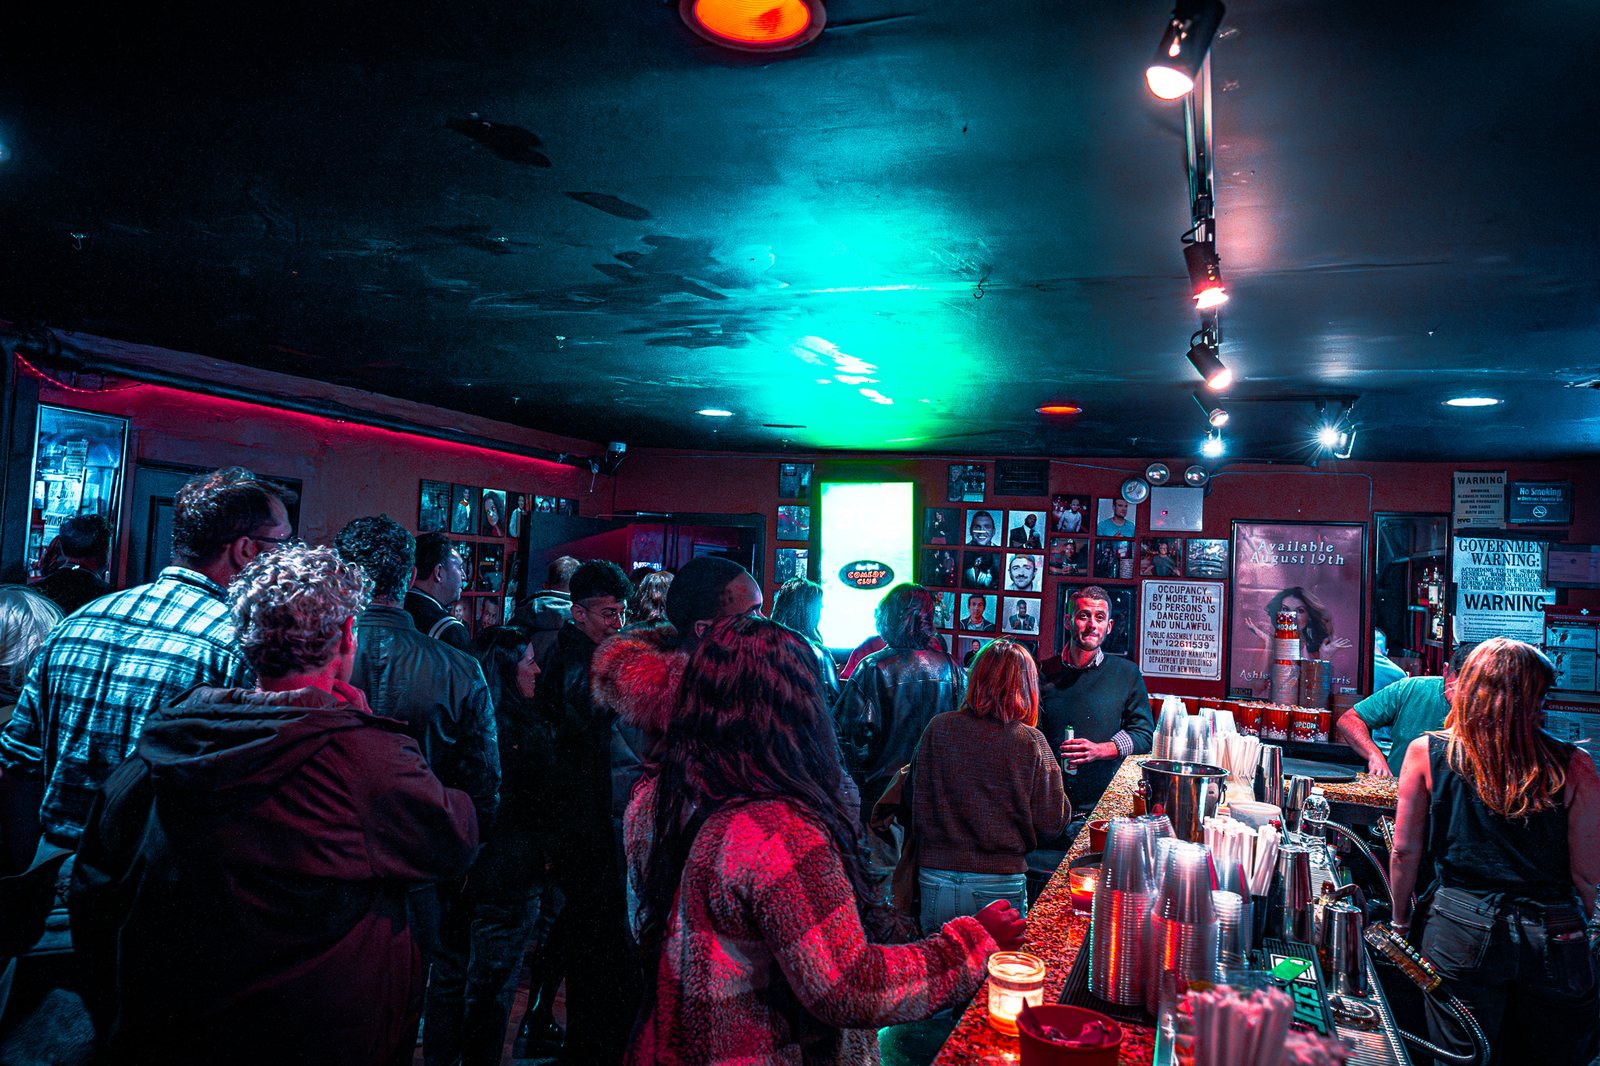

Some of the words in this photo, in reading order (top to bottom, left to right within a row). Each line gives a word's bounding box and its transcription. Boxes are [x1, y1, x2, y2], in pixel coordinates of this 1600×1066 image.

[1457, 476, 1503, 485] WARNING
[1520, 487, 1530, 495] No
[1531, 487, 1562, 496] Smoking
[1257, 540, 1334, 555] Available
[1459, 538, 1545, 554] GOVERNMEN
[1250, 551, 1305, 566] August
[1310, 553, 1345, 565] 19th
[1471, 552, 1540, 567] WARNING:
[848, 571, 886, 579] COMEDY
[1157, 585, 1208, 595] OCCUPANCY
[1152, 593, 1163, 602] BY
[1165, 594, 1188, 604] MORE
[1191, 595, 1212, 605] THAN
[1464, 593, 1546, 612] WARNING
[1149, 602, 1162, 611] 150
[1165, 603, 1203, 613] PERSONS
[1207, 605, 1216, 614] IS
[1157, 611, 1207, 622] DANGEROUS
[1150, 620, 1166, 629] AND
[1169, 621, 1213, 632] UNLAWFUL
[1147, 631, 1166, 639] PUBLIC
[1166, 632, 1193, 641] ASSEMBLY
[1193, 633, 1215, 642] LICENSE
[1165, 639, 1210, 650] 122611539
[1145, 647, 1180, 657] COMMISSIONER
[1188, 651, 1217, 659] MANHATTAN
[1149, 655, 1180, 665] DEPARTMENT
[1180, 657, 1186, 665] OF
[1186, 658, 1213, 667] BUILDINGS
[1158, 664, 1169, 672] CITY
[1188, 666, 1202, 674] YORK
[1239, 669, 1270, 681] Ashle
